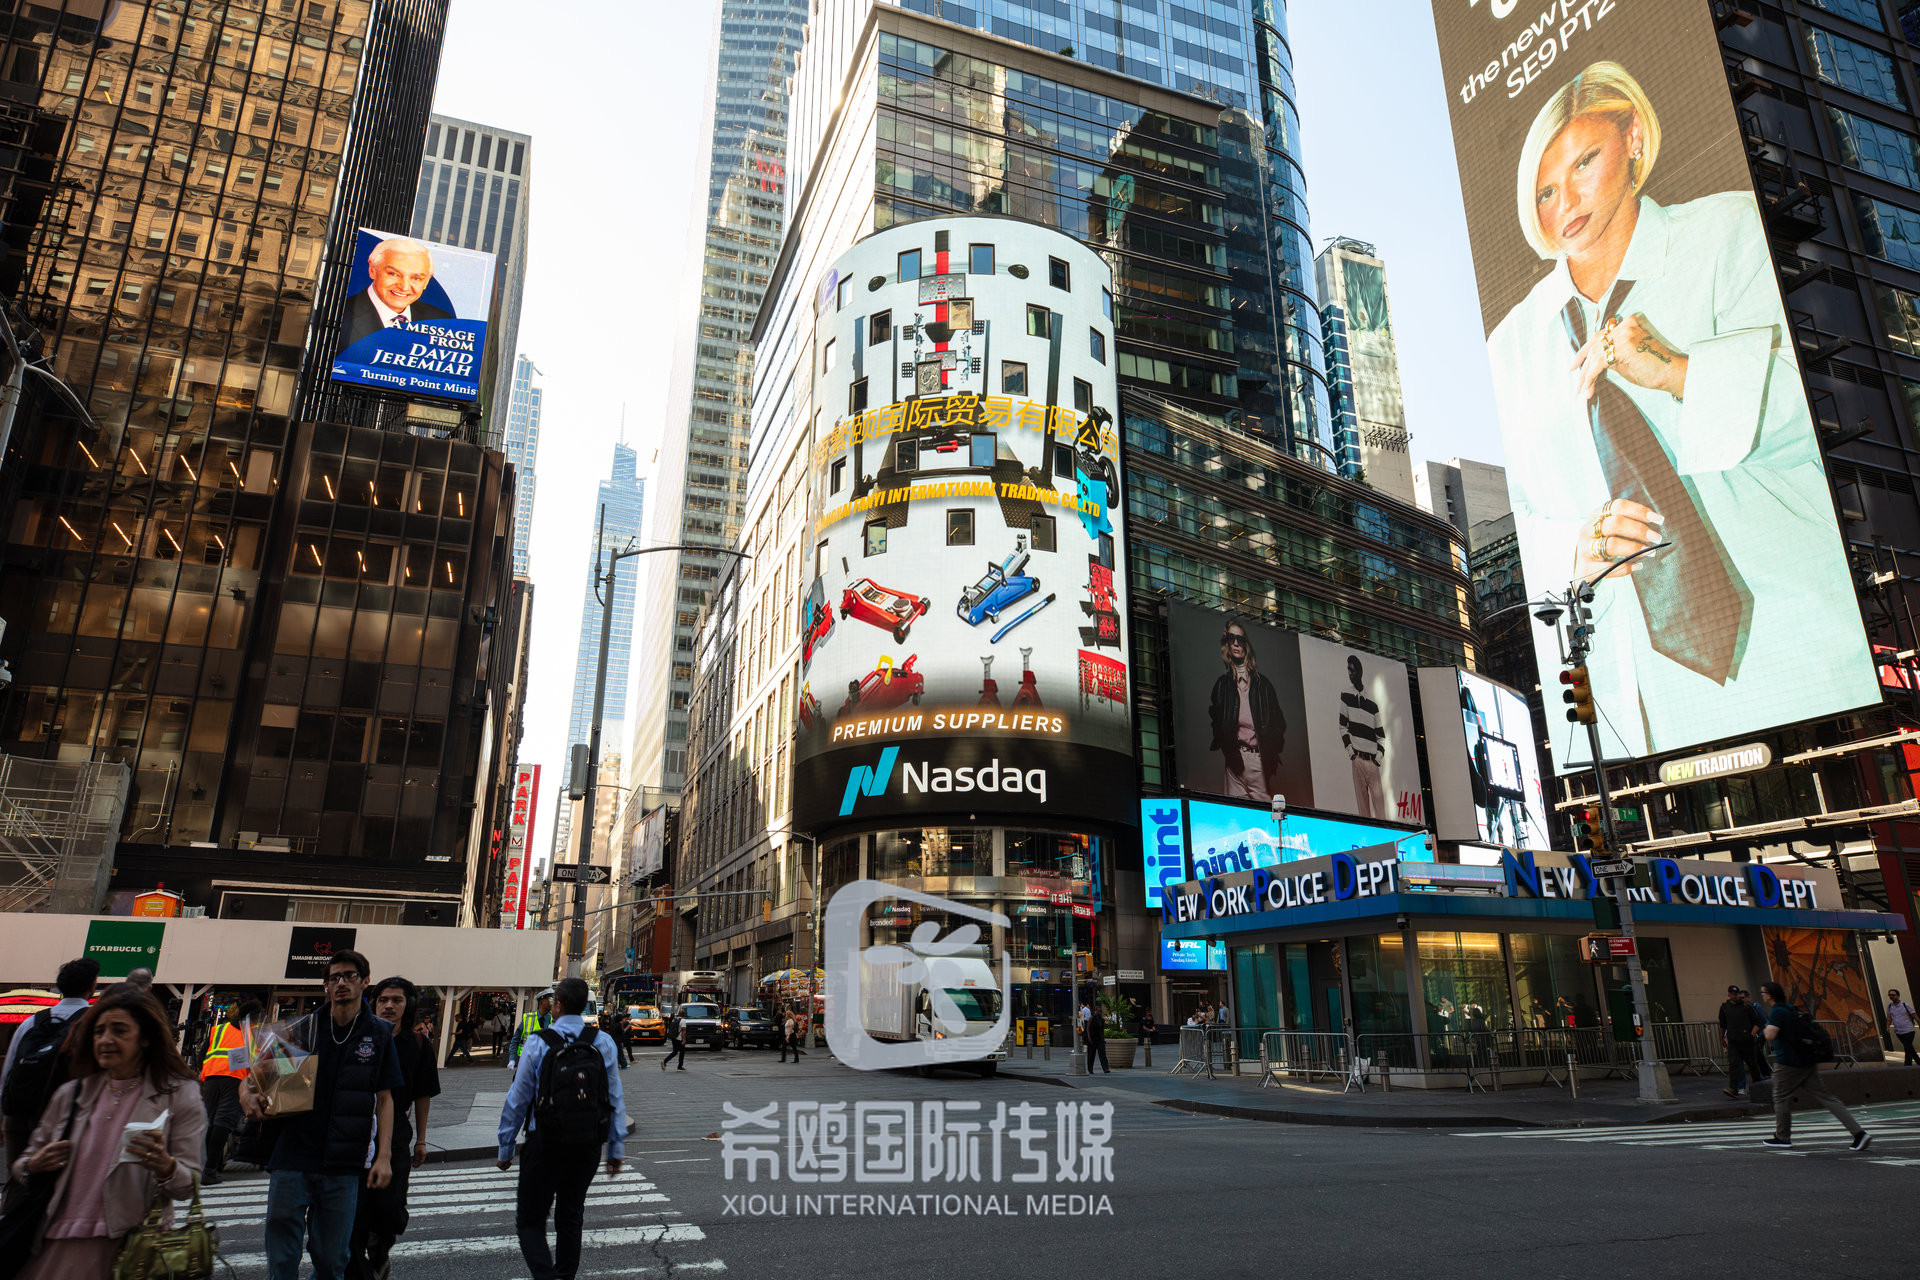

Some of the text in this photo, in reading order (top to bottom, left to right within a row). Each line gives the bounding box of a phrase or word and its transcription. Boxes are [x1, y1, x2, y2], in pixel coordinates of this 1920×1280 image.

[1460, 1, 1557, 104] the new
[391, 319, 476, 342] A MESSAGE
[429, 336, 474, 351] FROM
[370, 349, 472, 377] JEREMIAH
[409, 343, 474, 365] DAVID
[360, 369, 478, 395] Turning Point Minis
[813, 500, 852, 536] SHANGHAI
[852, 490, 887, 514] FANYI
[887, 481, 997, 504] INTERNATIONAL
[1000, 483, 1059, 505] TRADING
[833, 713, 1063, 742] PREMIUM SUPPLIERS
[902, 758, 1047, 804] Nasdaq
[513, 772, 531, 825] PARK
[1397, 790, 1422, 822] H&M
[1147, 808, 1186, 898] hint
[1192, 840, 1253, 880] hint
[561, 869, 578, 877] ONE
[1502, 847, 1576, 899] NEW
[1654, 858, 1749, 907] POLICE
[1749, 863, 1818, 909] DEPT
[1595, 863, 1628, 873] ONE WAY
[503, 858, 521, 913] PARK
[1161, 853, 1398, 924] NEW YORK POLICE DEPT
[892, 905, 911, 914] Nasdaq
[1026, 906, 1047, 914] Nasdaq
[89, 945, 142, 953] STARBUCKS
